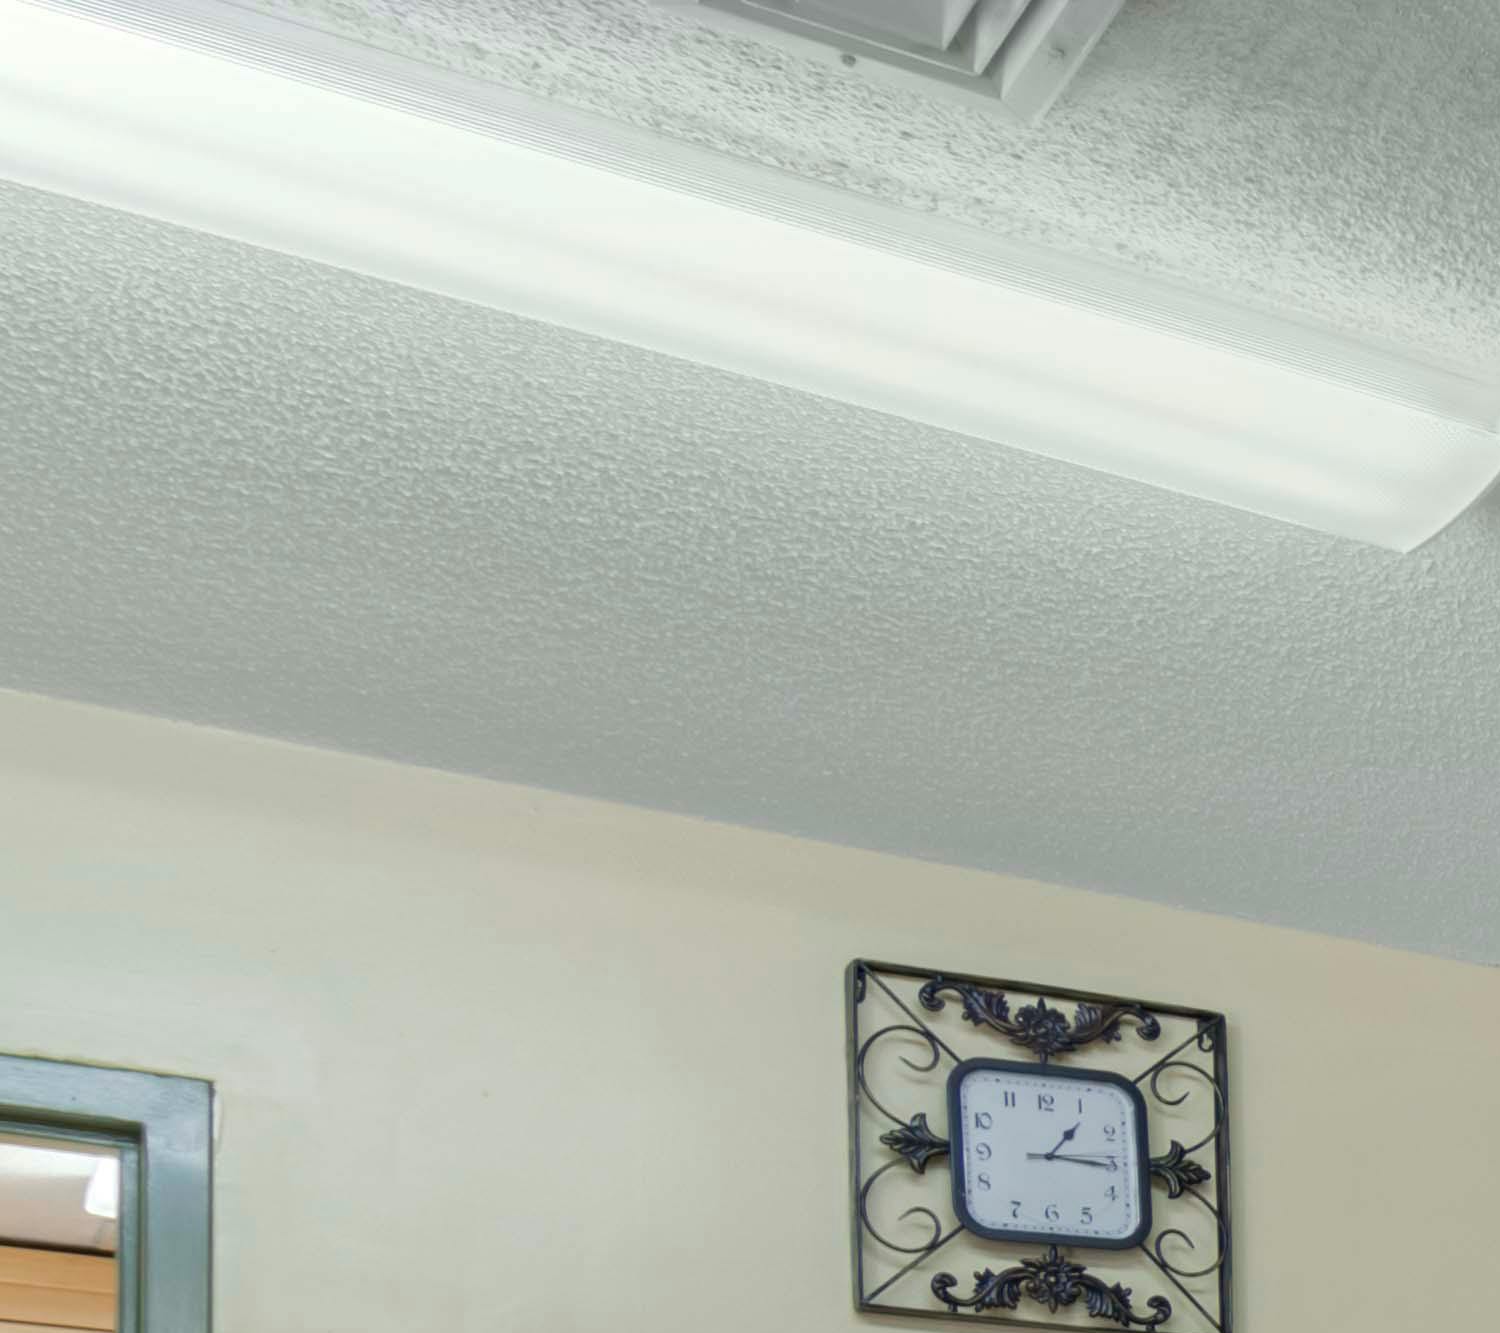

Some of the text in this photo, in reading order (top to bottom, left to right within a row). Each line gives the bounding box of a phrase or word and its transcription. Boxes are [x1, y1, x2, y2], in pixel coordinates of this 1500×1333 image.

[1004, 1091, 1015, 1108] 11
[1038, 1093, 1054, 1112] 12
[1077, 1098, 1082, 1114] 1
[975, 1112, 992, 1130] 10
[1104, 1125, 1116, 1142] 2
[976, 1142, 992, 1160] 9
[978, 1172, 991, 1191] 8
[1104, 1185, 1119, 1201] 4
[1011, 1200, 1021, 1218] 7
[1045, 1204, 1059, 1221] 6
[1080, 1207, 1093, 1224] 5
